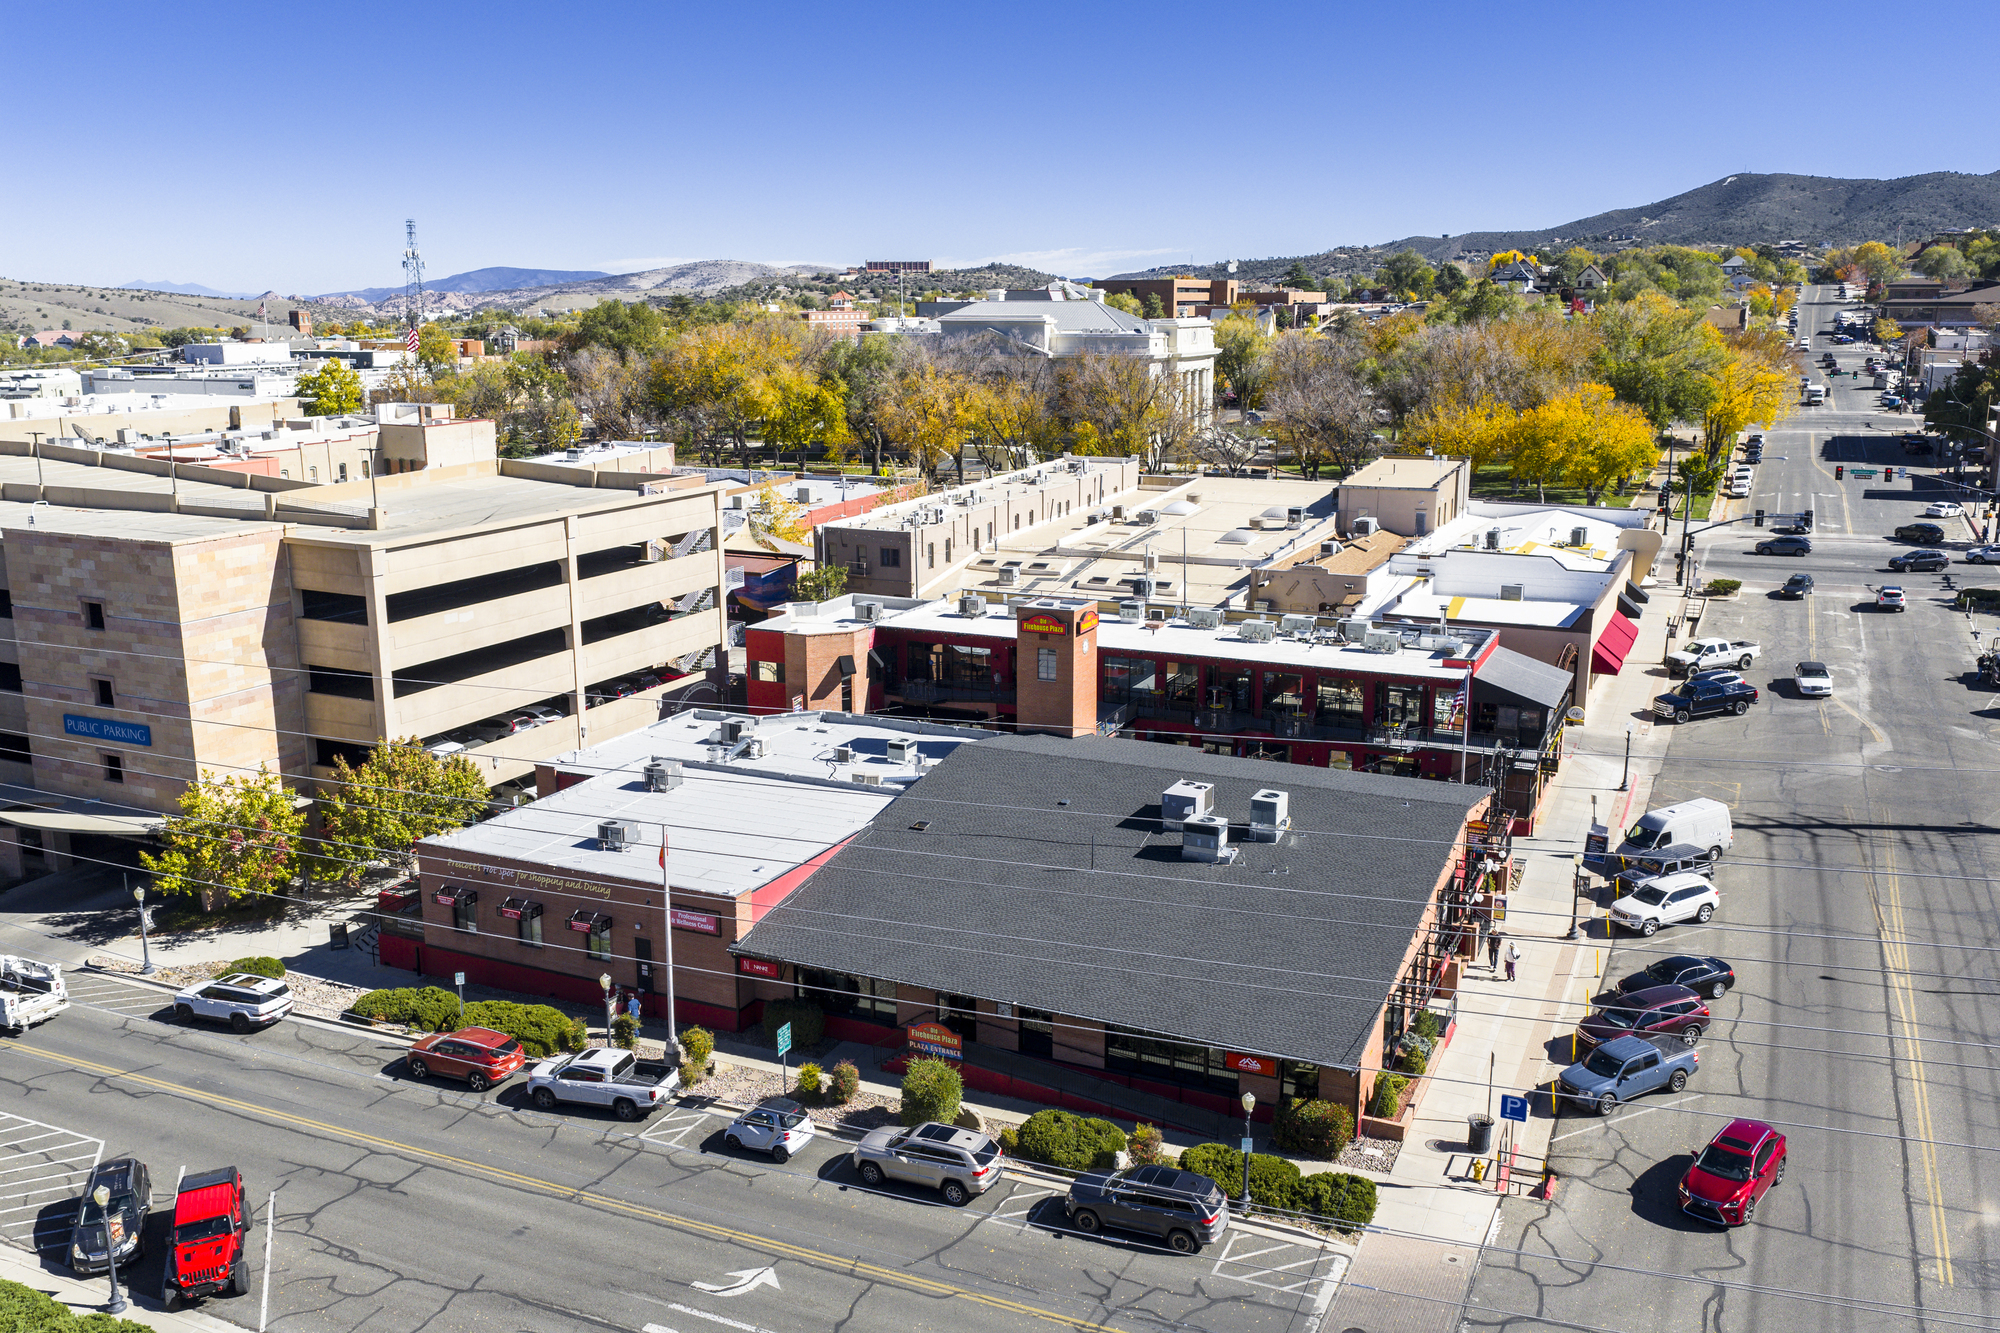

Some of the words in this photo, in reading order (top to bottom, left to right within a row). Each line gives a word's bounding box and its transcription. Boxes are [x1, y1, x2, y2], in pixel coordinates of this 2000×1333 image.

[1023, 623, 1049, 632] Firehouse
[1050, 625, 1064, 633] Plaza
[67, 719, 99, 735] PUBLIC
[103, 725, 146, 742] PARKING
[515, 871, 528, 883] for
[565, 880, 583, 890] and
[583, 882, 611, 899] Dining
[676, 918, 697, 927] Wellness
[697, 922, 714, 931] Center
[678, 912, 707, 923] Professional
[911, 1028, 941, 1042] Firehouse
[941, 1035, 958, 1046] Plaza
[930, 1027, 938, 1035] Old
[909, 1040, 929, 1051] PLAZA
[930, 1045, 961, 1057] ENTRANCE
[1506, 1097, 1522, 1114] P
